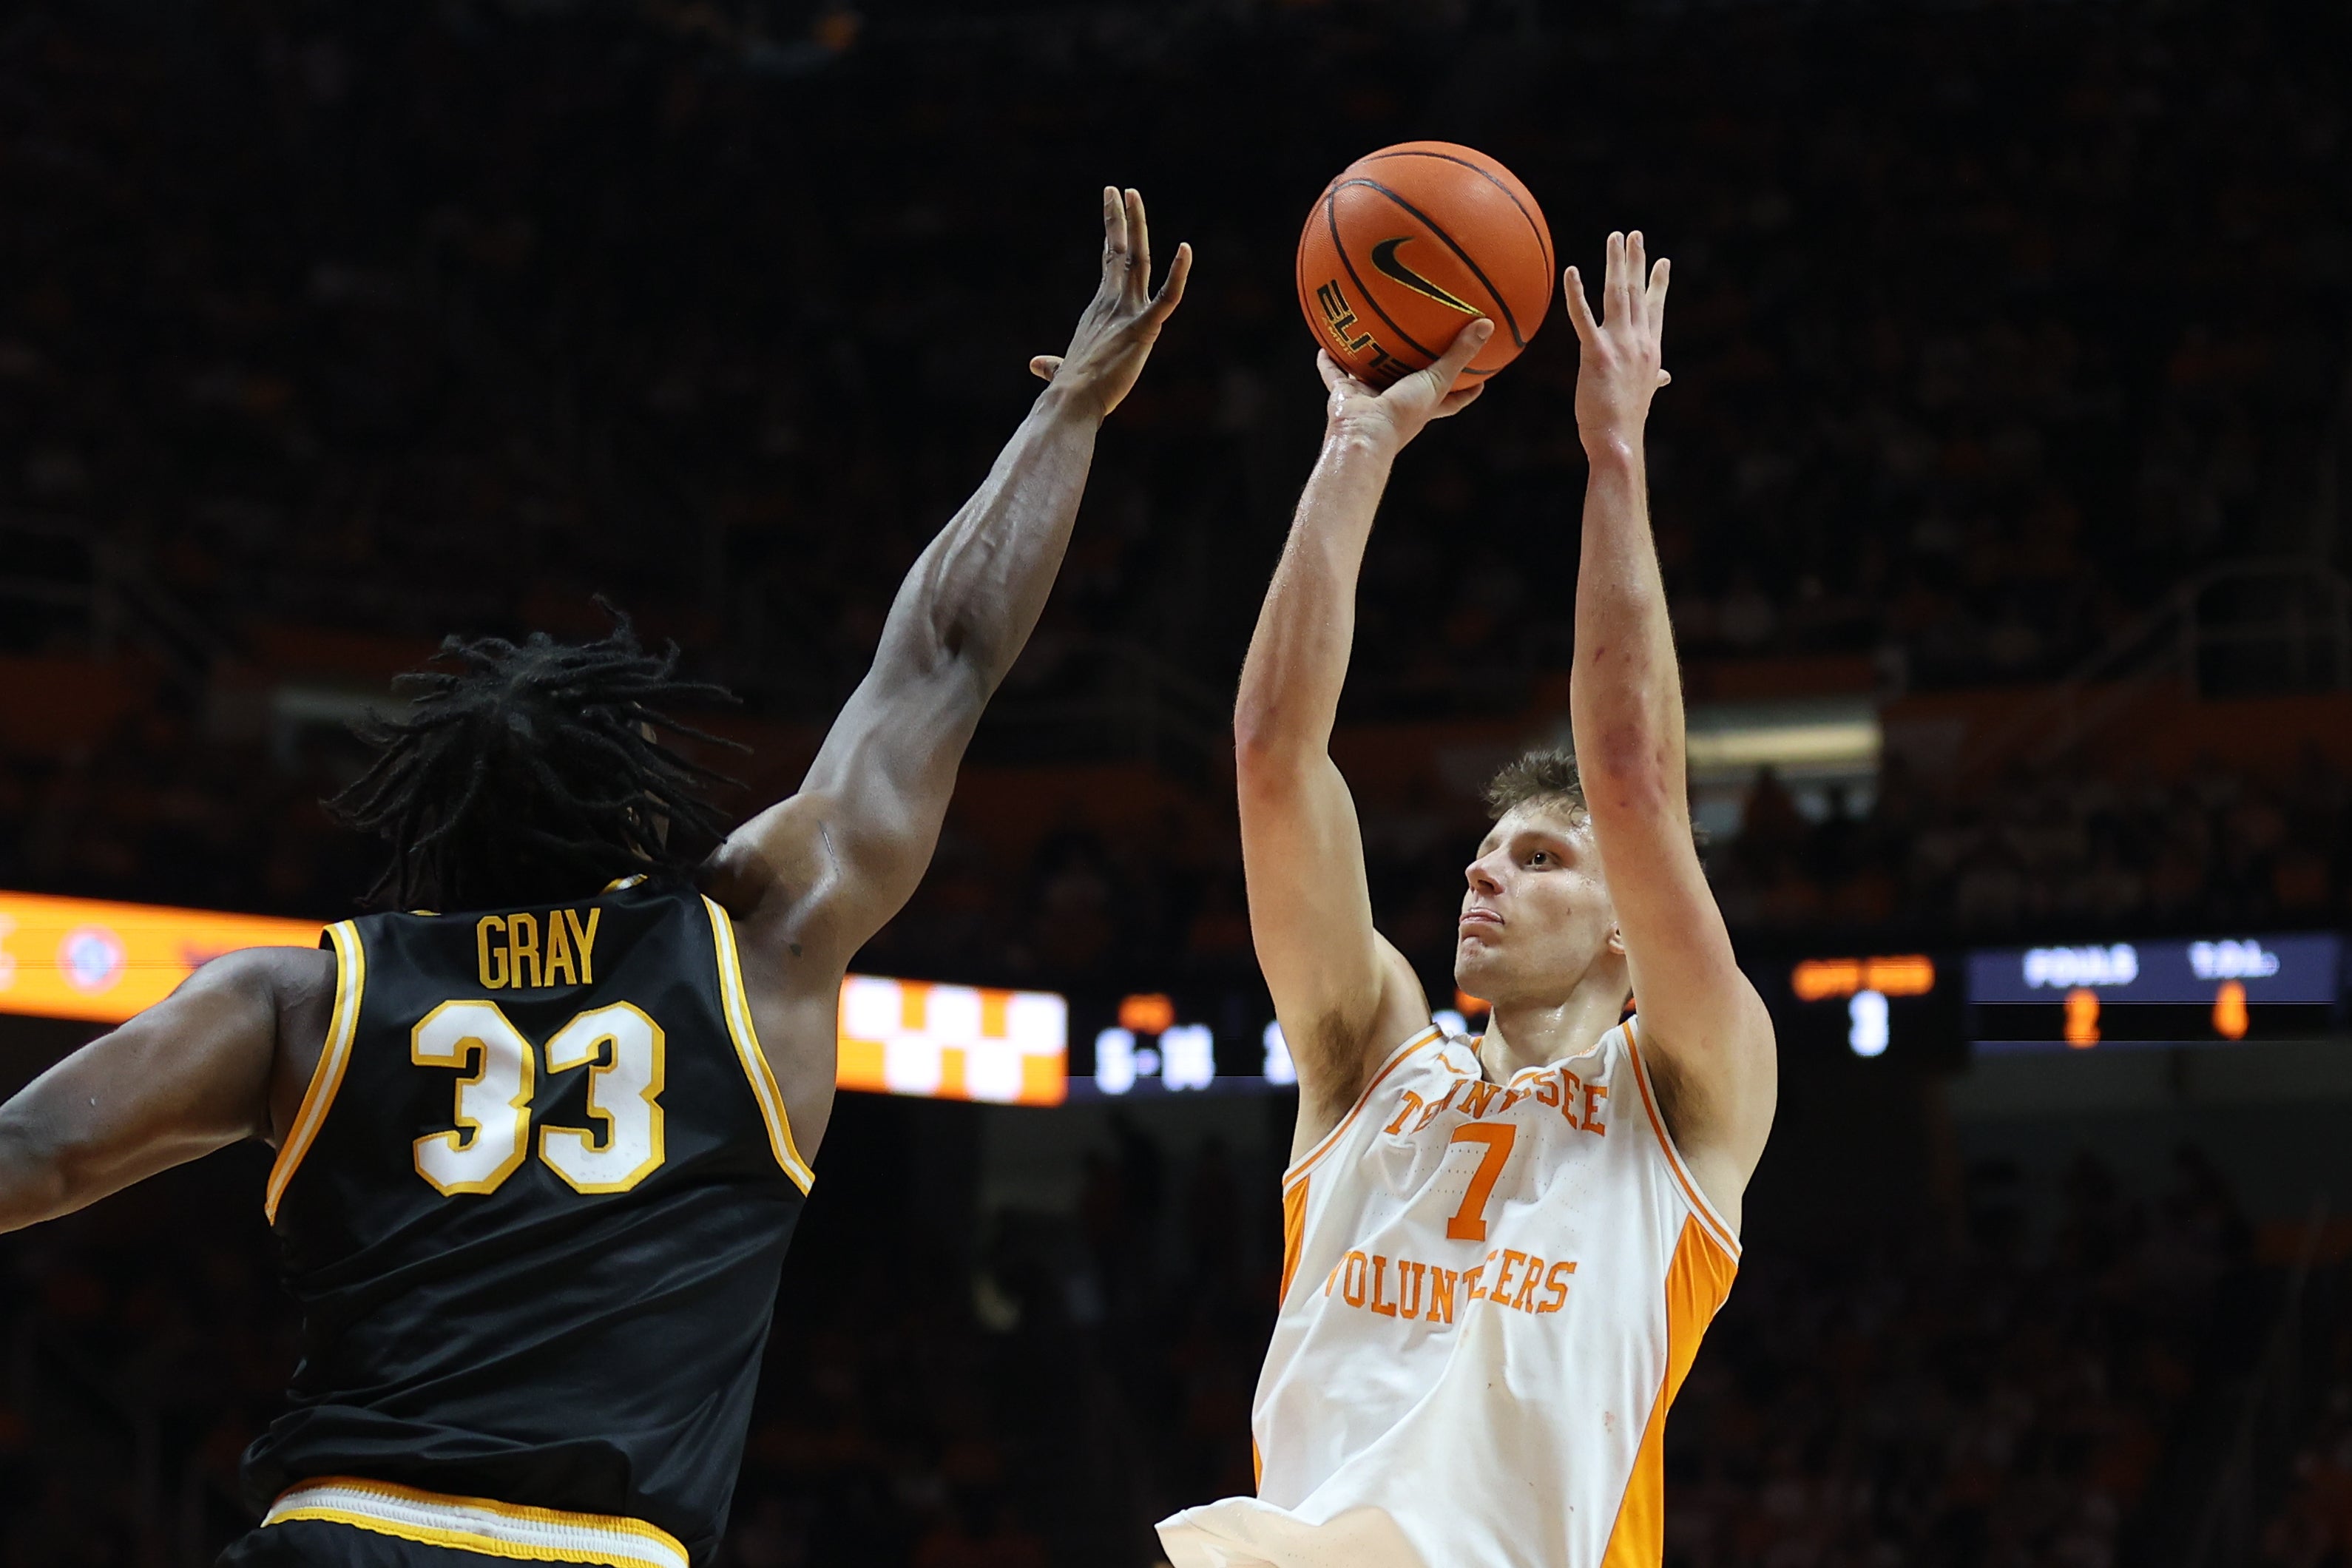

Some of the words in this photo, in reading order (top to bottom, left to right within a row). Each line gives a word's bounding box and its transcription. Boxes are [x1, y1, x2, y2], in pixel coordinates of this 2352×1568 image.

[1317, 279, 1419, 380] ELITE
[477, 908, 601, 989] GRAY
[410, 1000, 665, 1197] 33
[1384, 1067, 1609, 1137] TENSEE
[1446, 1122, 1517, 1242] 7
